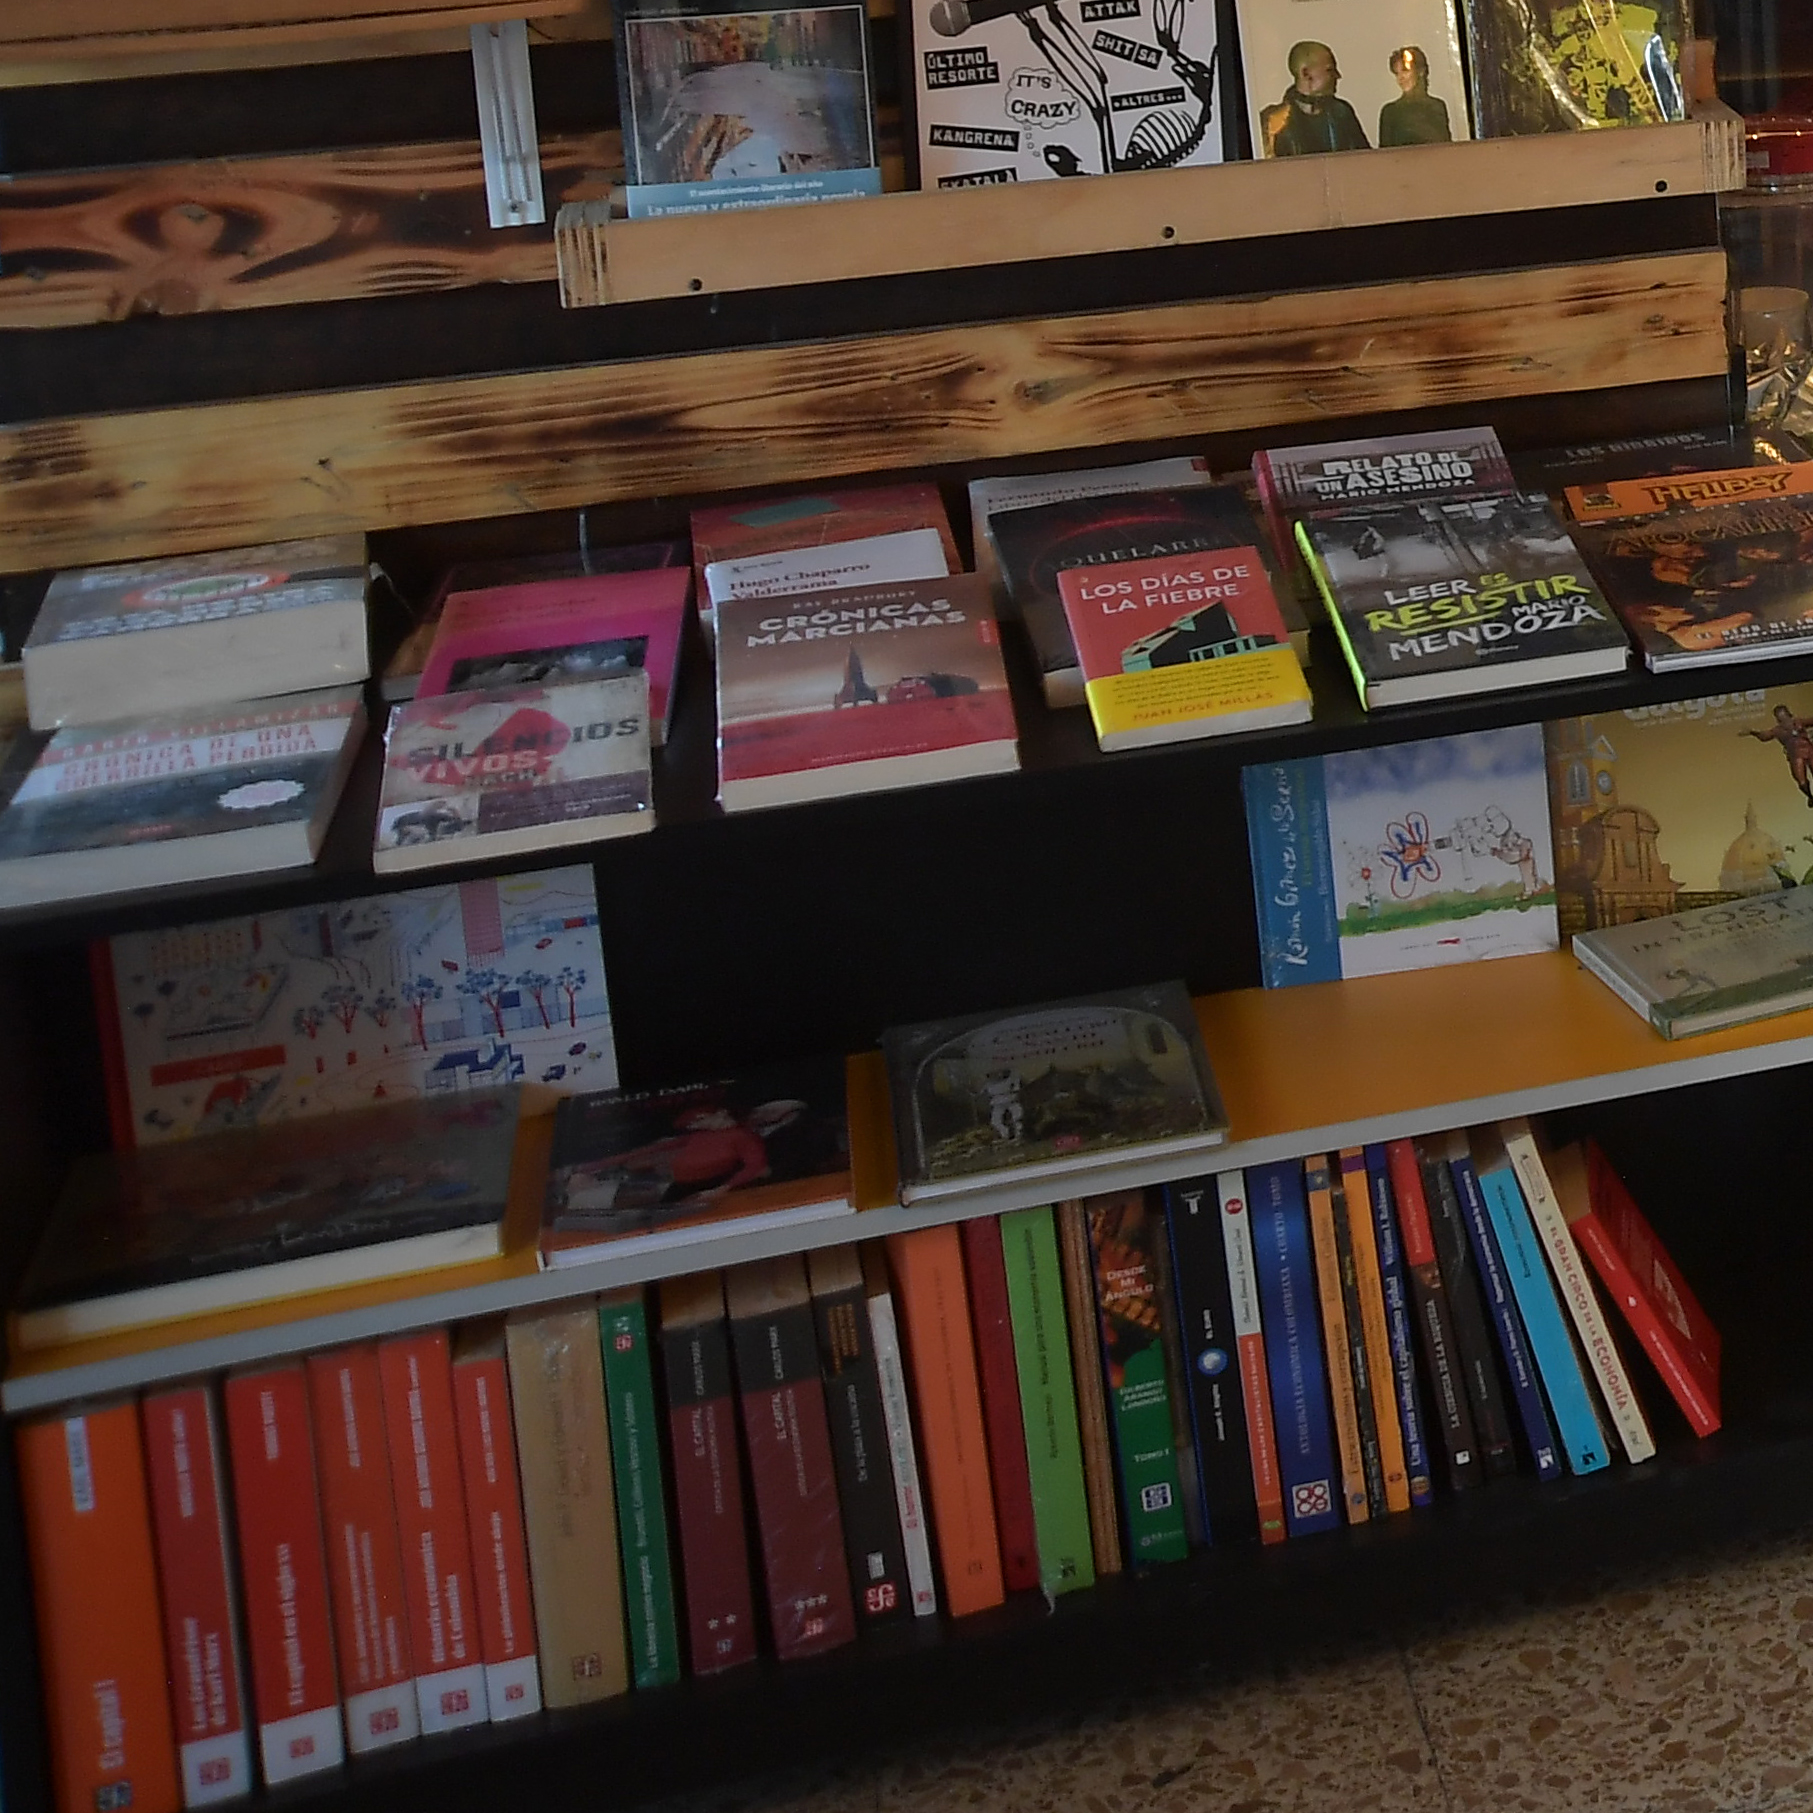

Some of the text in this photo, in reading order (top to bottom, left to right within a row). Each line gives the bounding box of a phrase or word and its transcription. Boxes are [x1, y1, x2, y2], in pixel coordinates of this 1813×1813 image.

[1084, 0, 1137, 18] ATTAK
[928, 67, 996, 84] RESORTE
[1016, 75, 1051, 88] IT'S
[1011, 100, 1077, 118] CRAZY
[932, 129, 1015, 147] KANGRENA
[1315, 460, 1474, 494] UN ASESINO
[1322, 452, 1433, 477] RELATO
[1320, 478, 1476, 501] MARIO MENDOZA
[1642, 471, 1793, 505] HELLBOY
[1080, 564, 1251, 601] LOS DÍAS DE
[1383, 579, 1477, 606] LEER
[1101, 584, 1240, 615] LA FIEBRE
[1363, 574, 1591, 634] RESISTIR
[1511, 595, 1586, 617] MARIO
[759, 598, 950, 631] CRÓNICAS
[746, 611, 966, 648] MARCIANAS
[1387, 604, 1607, 662] MENDOZA
[1670, 895, 1791, 933] LOST
